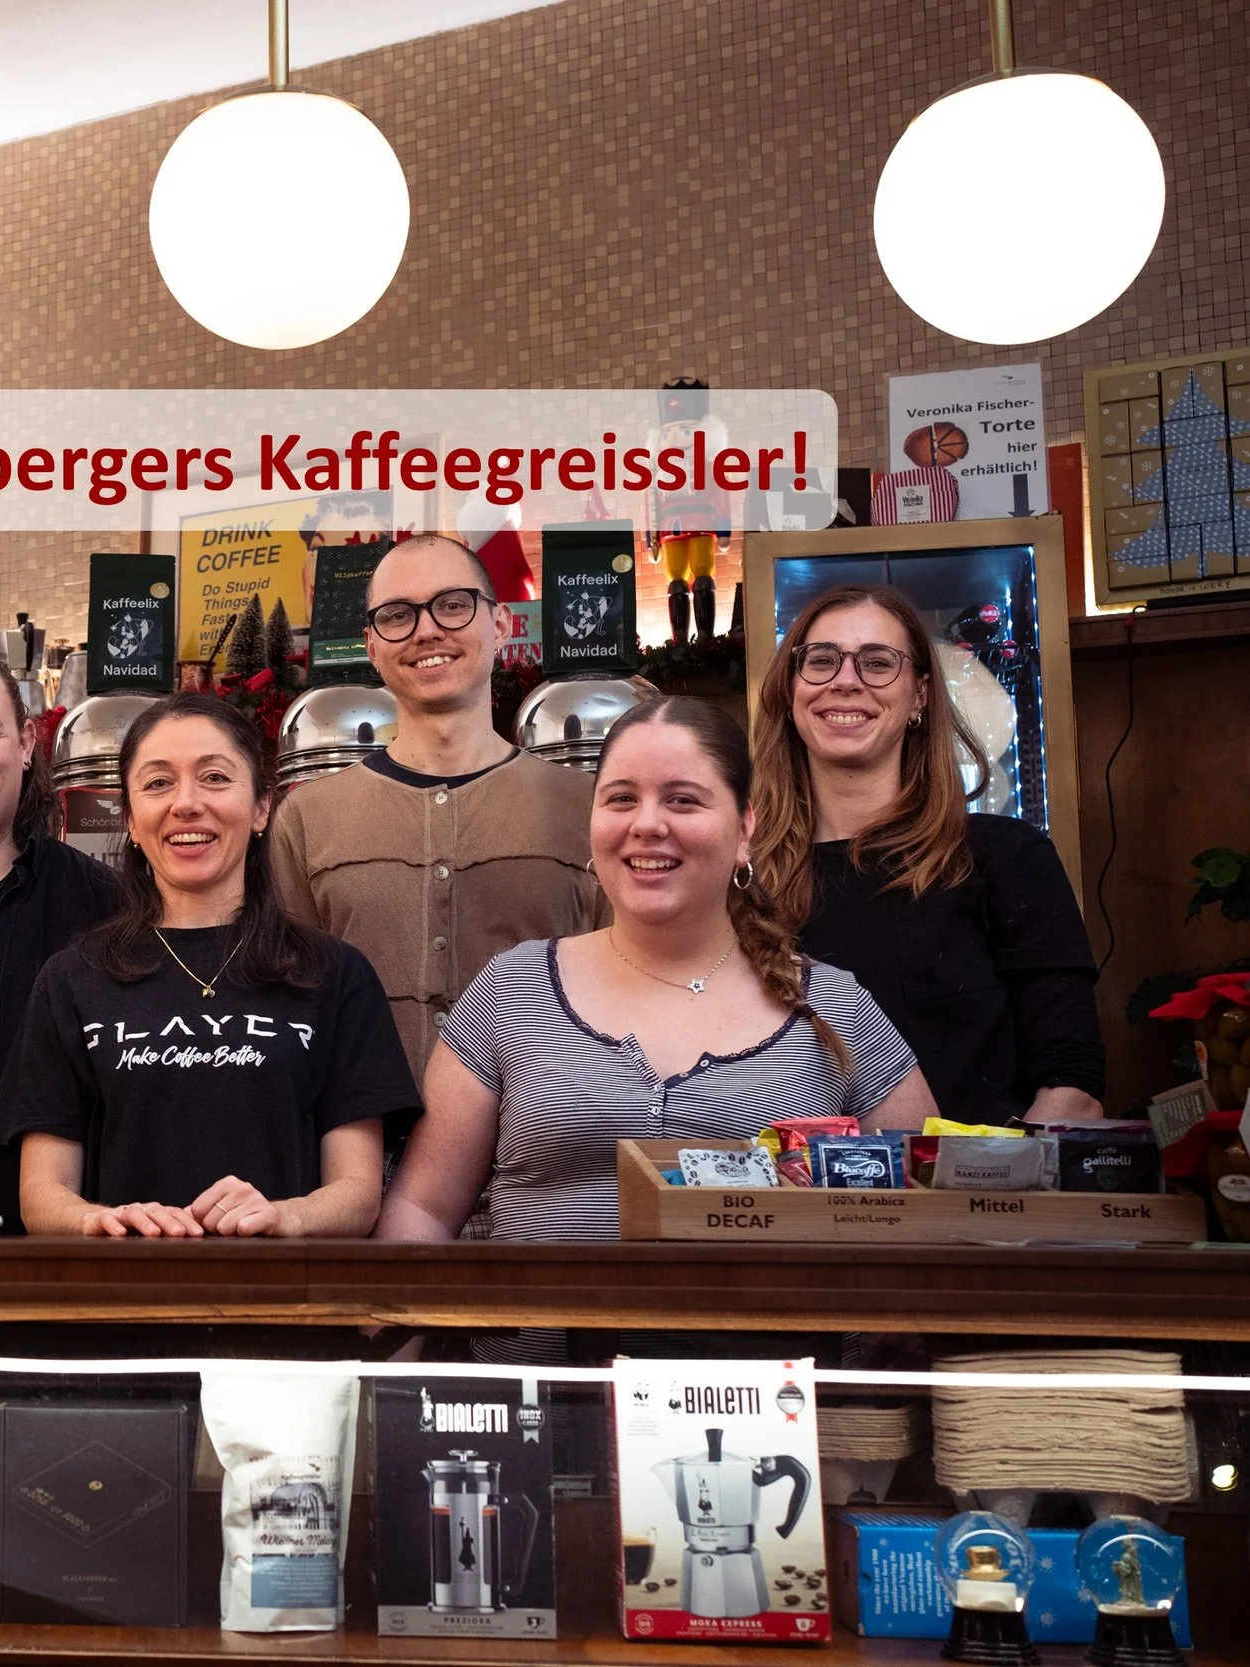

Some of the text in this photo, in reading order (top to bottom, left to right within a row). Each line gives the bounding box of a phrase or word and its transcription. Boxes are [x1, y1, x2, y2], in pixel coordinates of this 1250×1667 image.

[906, 397, 1036, 419] Veronika Fischer-
[979, 418, 1036, 434] Torte
[1006, 441, 1038, 454] hier
[960, 460, 1038, 478] erhältlich!
[201, 518, 274, 548] DRINK
[196, 545, 282, 573] COFFEE
[201, 576, 271, 597] Do Stupid
[556, 573, 620, 587] Kaffeelix
[102, 597, 160, 610] Kaffeelix
[204, 597, 250, 610] Things
[559, 643, 618, 658] Navidad
[102, 663, 158, 677] Navidad
[115, 1045, 266, 1071] Make Coffee Better
[1082, 1155, 1132, 1174] gallitelli
[722, 1195, 755, 1208] BIO
[827, 1195, 906, 1206] 100% Arabica
[969, 1198, 1024, 1213] Mittel
[1101, 1203, 1152, 1219] Stark
[706, 1213, 775, 1229] DECAF
[519, 1409, 542, 1421] INOX
[444, 1616, 492, 1625] PREZIOSA
[689, 1619, 763, 1628] MOKA EXPRESS
